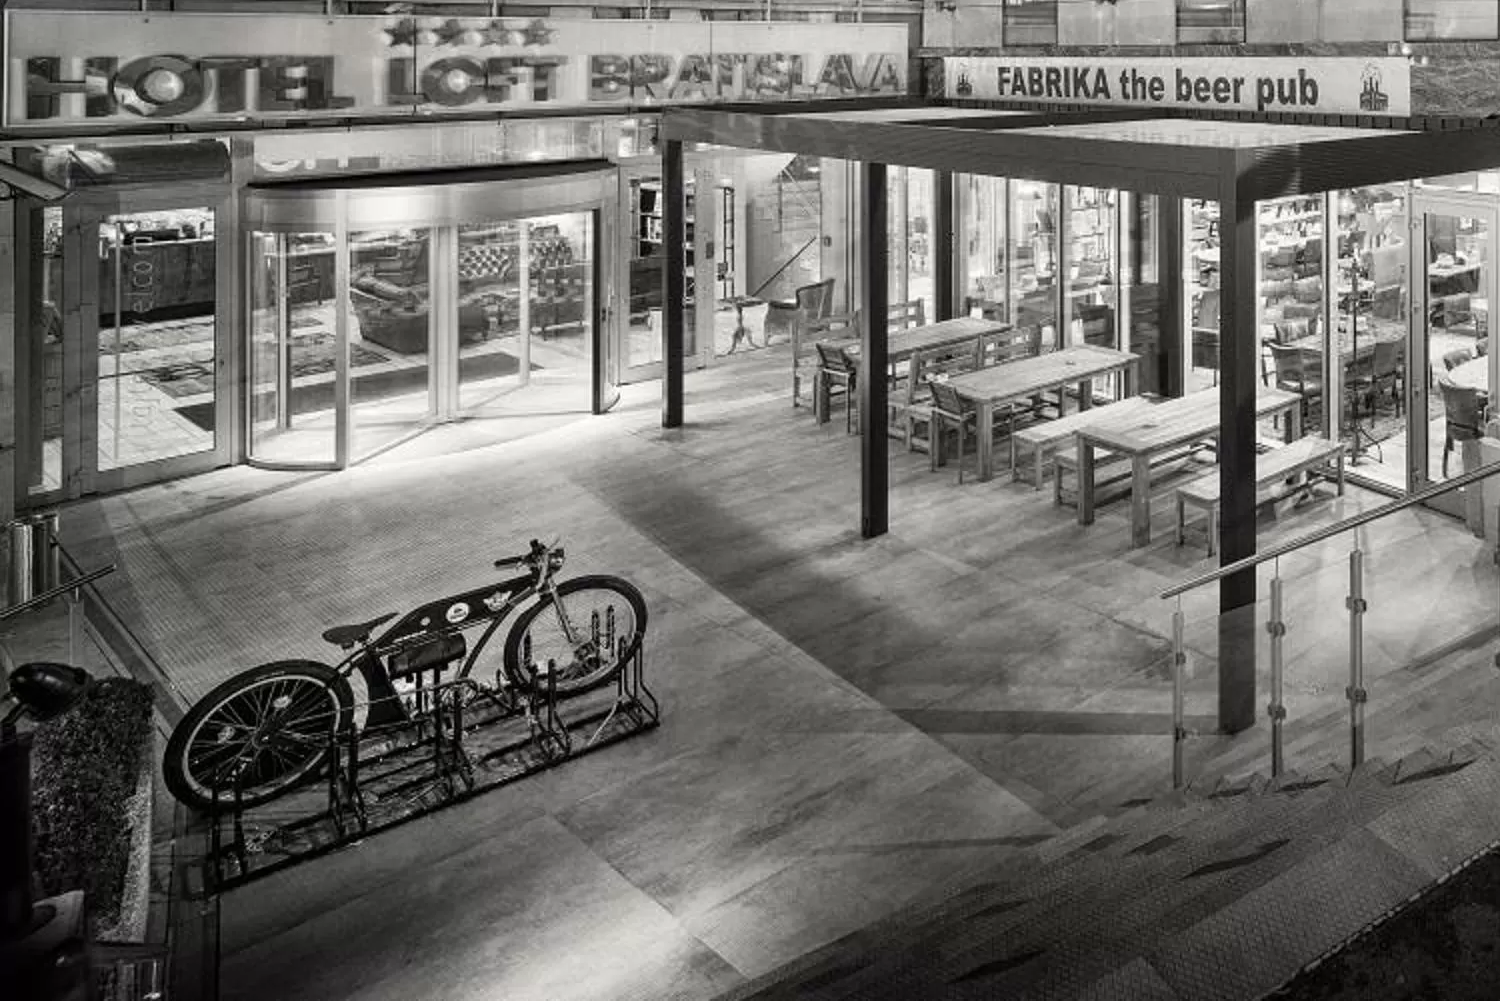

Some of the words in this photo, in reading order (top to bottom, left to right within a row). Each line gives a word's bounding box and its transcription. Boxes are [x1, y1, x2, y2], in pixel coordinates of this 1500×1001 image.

[26, 54, 354, 119] HOTEL
[386, 55, 567, 106] LOFT
[590, 53, 907, 100] BRATISLAVA
[997, 65, 1111, 100] FABRIKA
[1119, 69, 1165, 101] the
[1176, 68, 1246, 104] beer
[1257, 68, 1320, 112] pub
